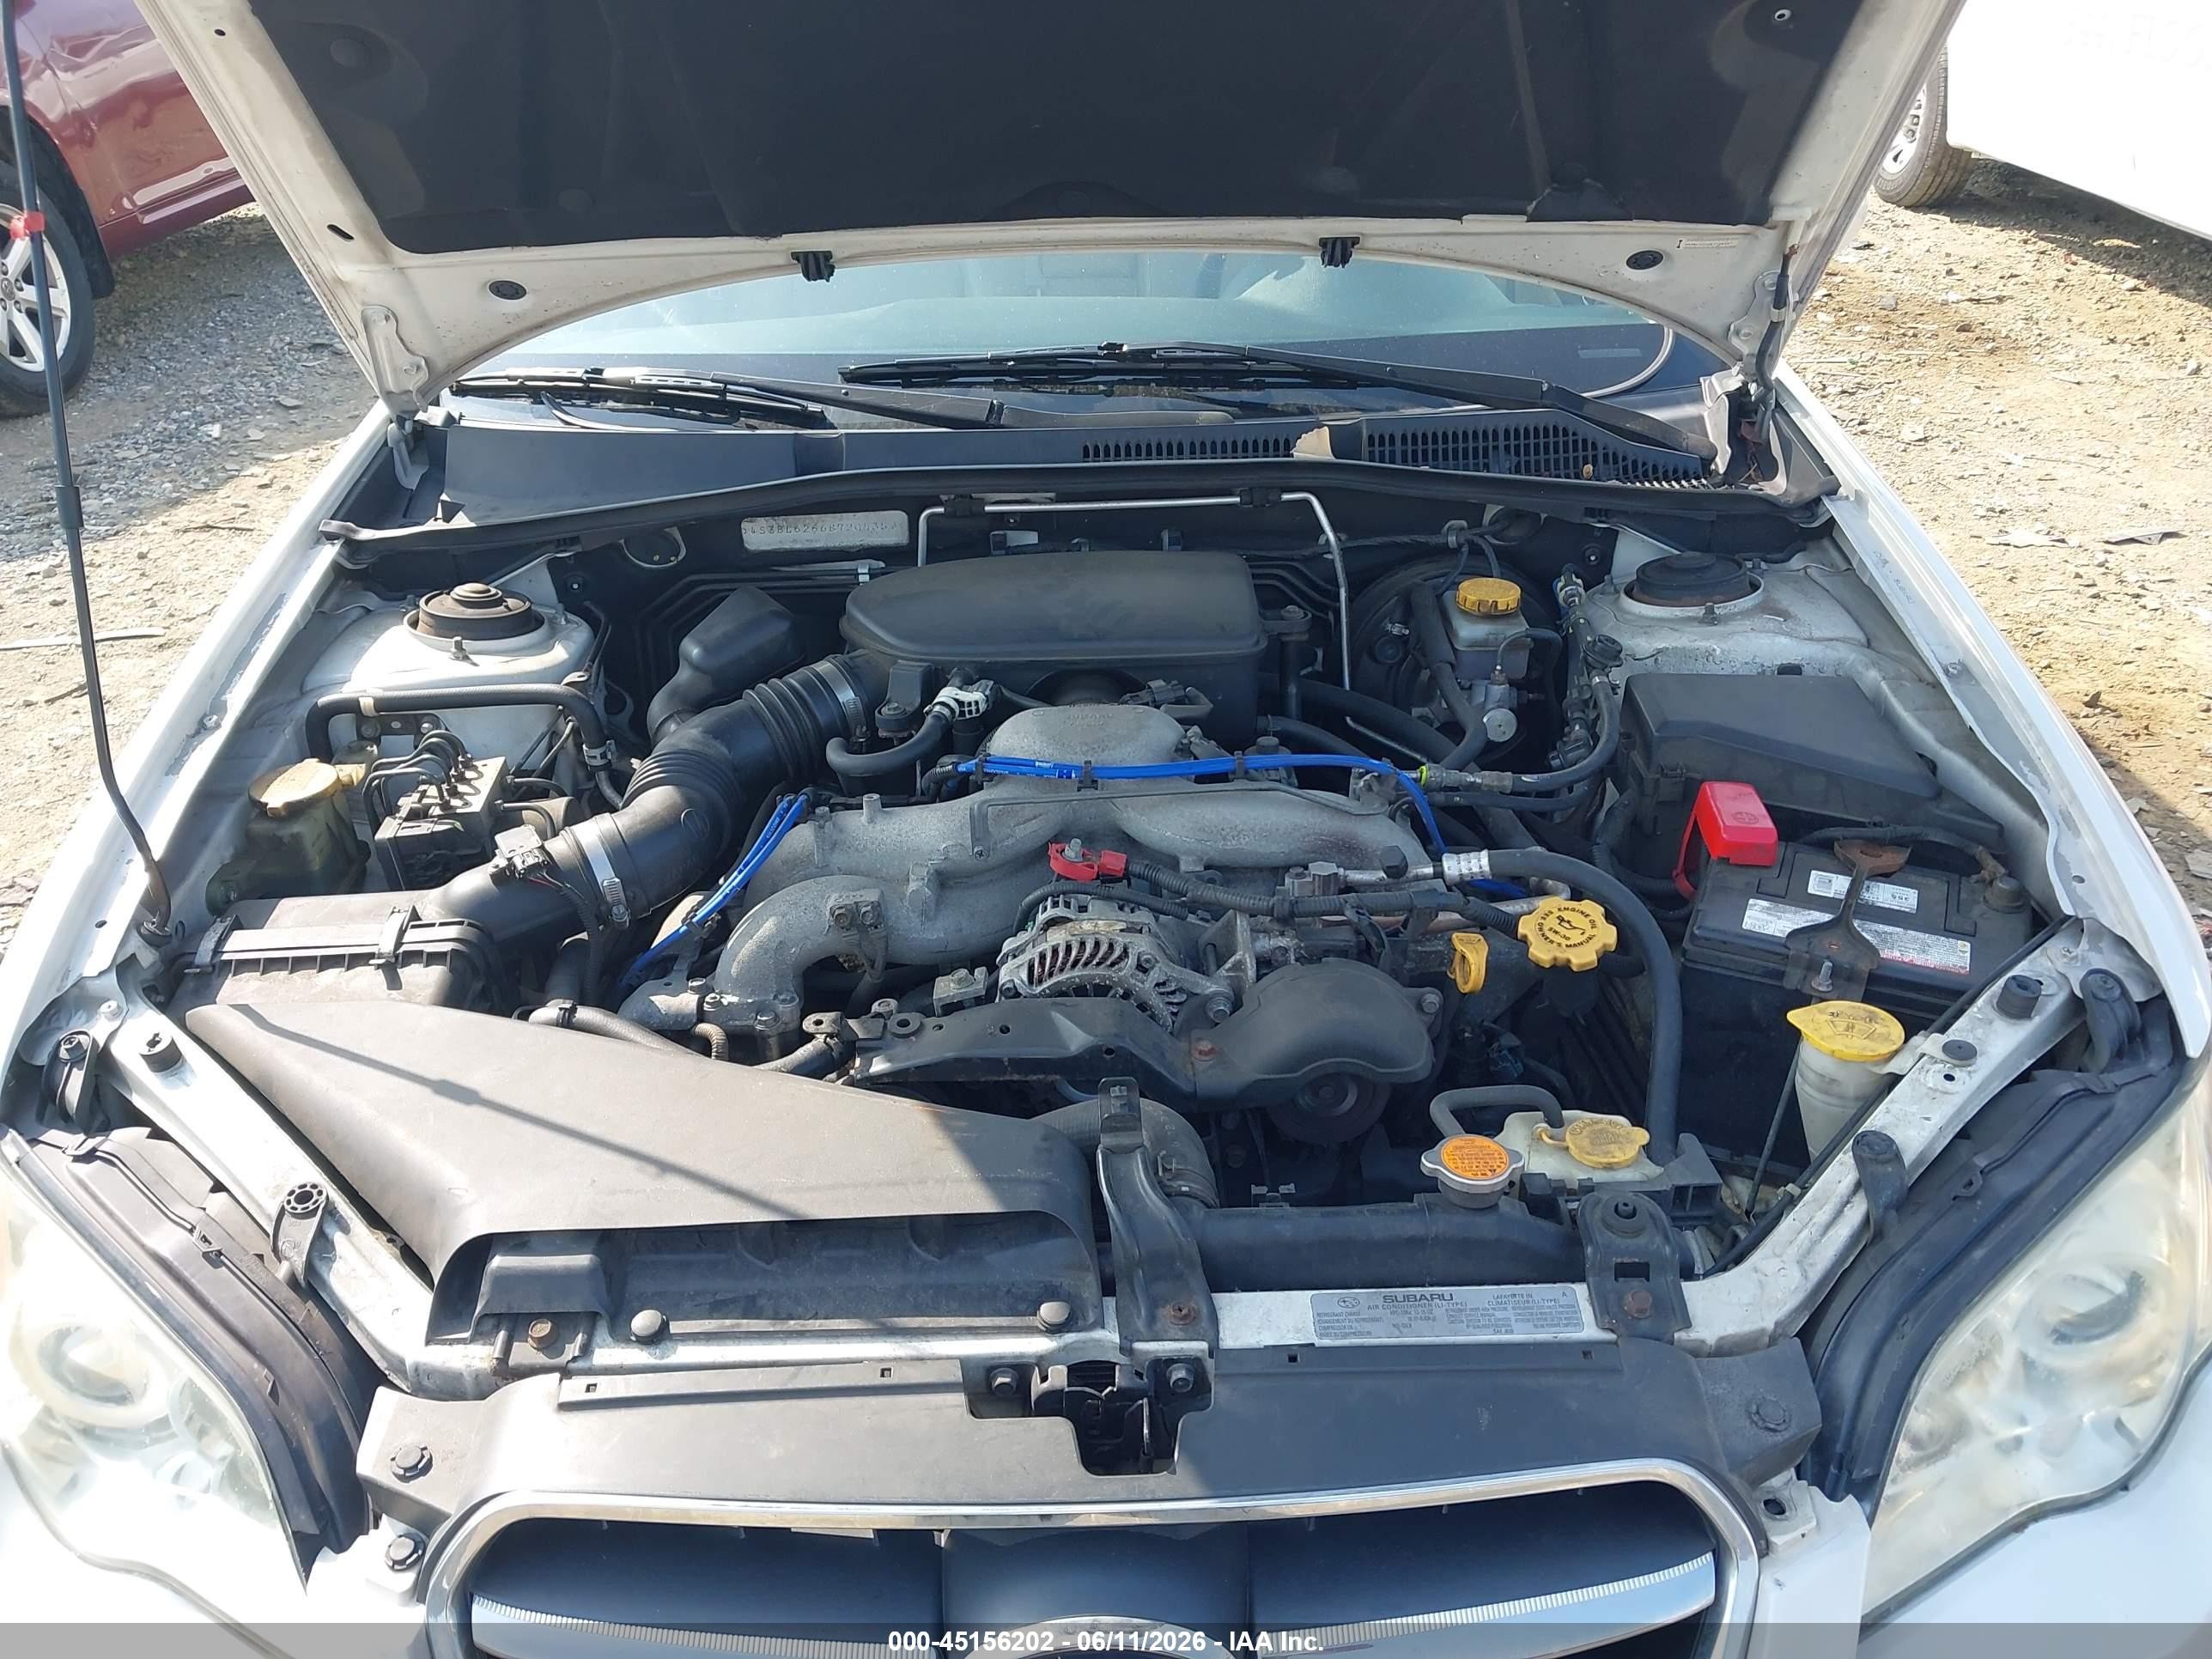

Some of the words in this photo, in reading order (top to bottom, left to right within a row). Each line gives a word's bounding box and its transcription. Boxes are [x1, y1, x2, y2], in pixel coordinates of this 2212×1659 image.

[1540, 910, 1553, 921] SEE
[1557, 907, 1591, 919] ENGINE
[1589, 919, 1597, 930] OIL
[1537, 921, 1563, 948] OWNER'S
[1547, 927, 1571, 941] 5W-30
[1565, 933, 1596, 948] MANUAL
[1382, 1292, 1454, 1304] SUBARU
[1530, 1297, 1560, 1306] (LI-TYPE)
